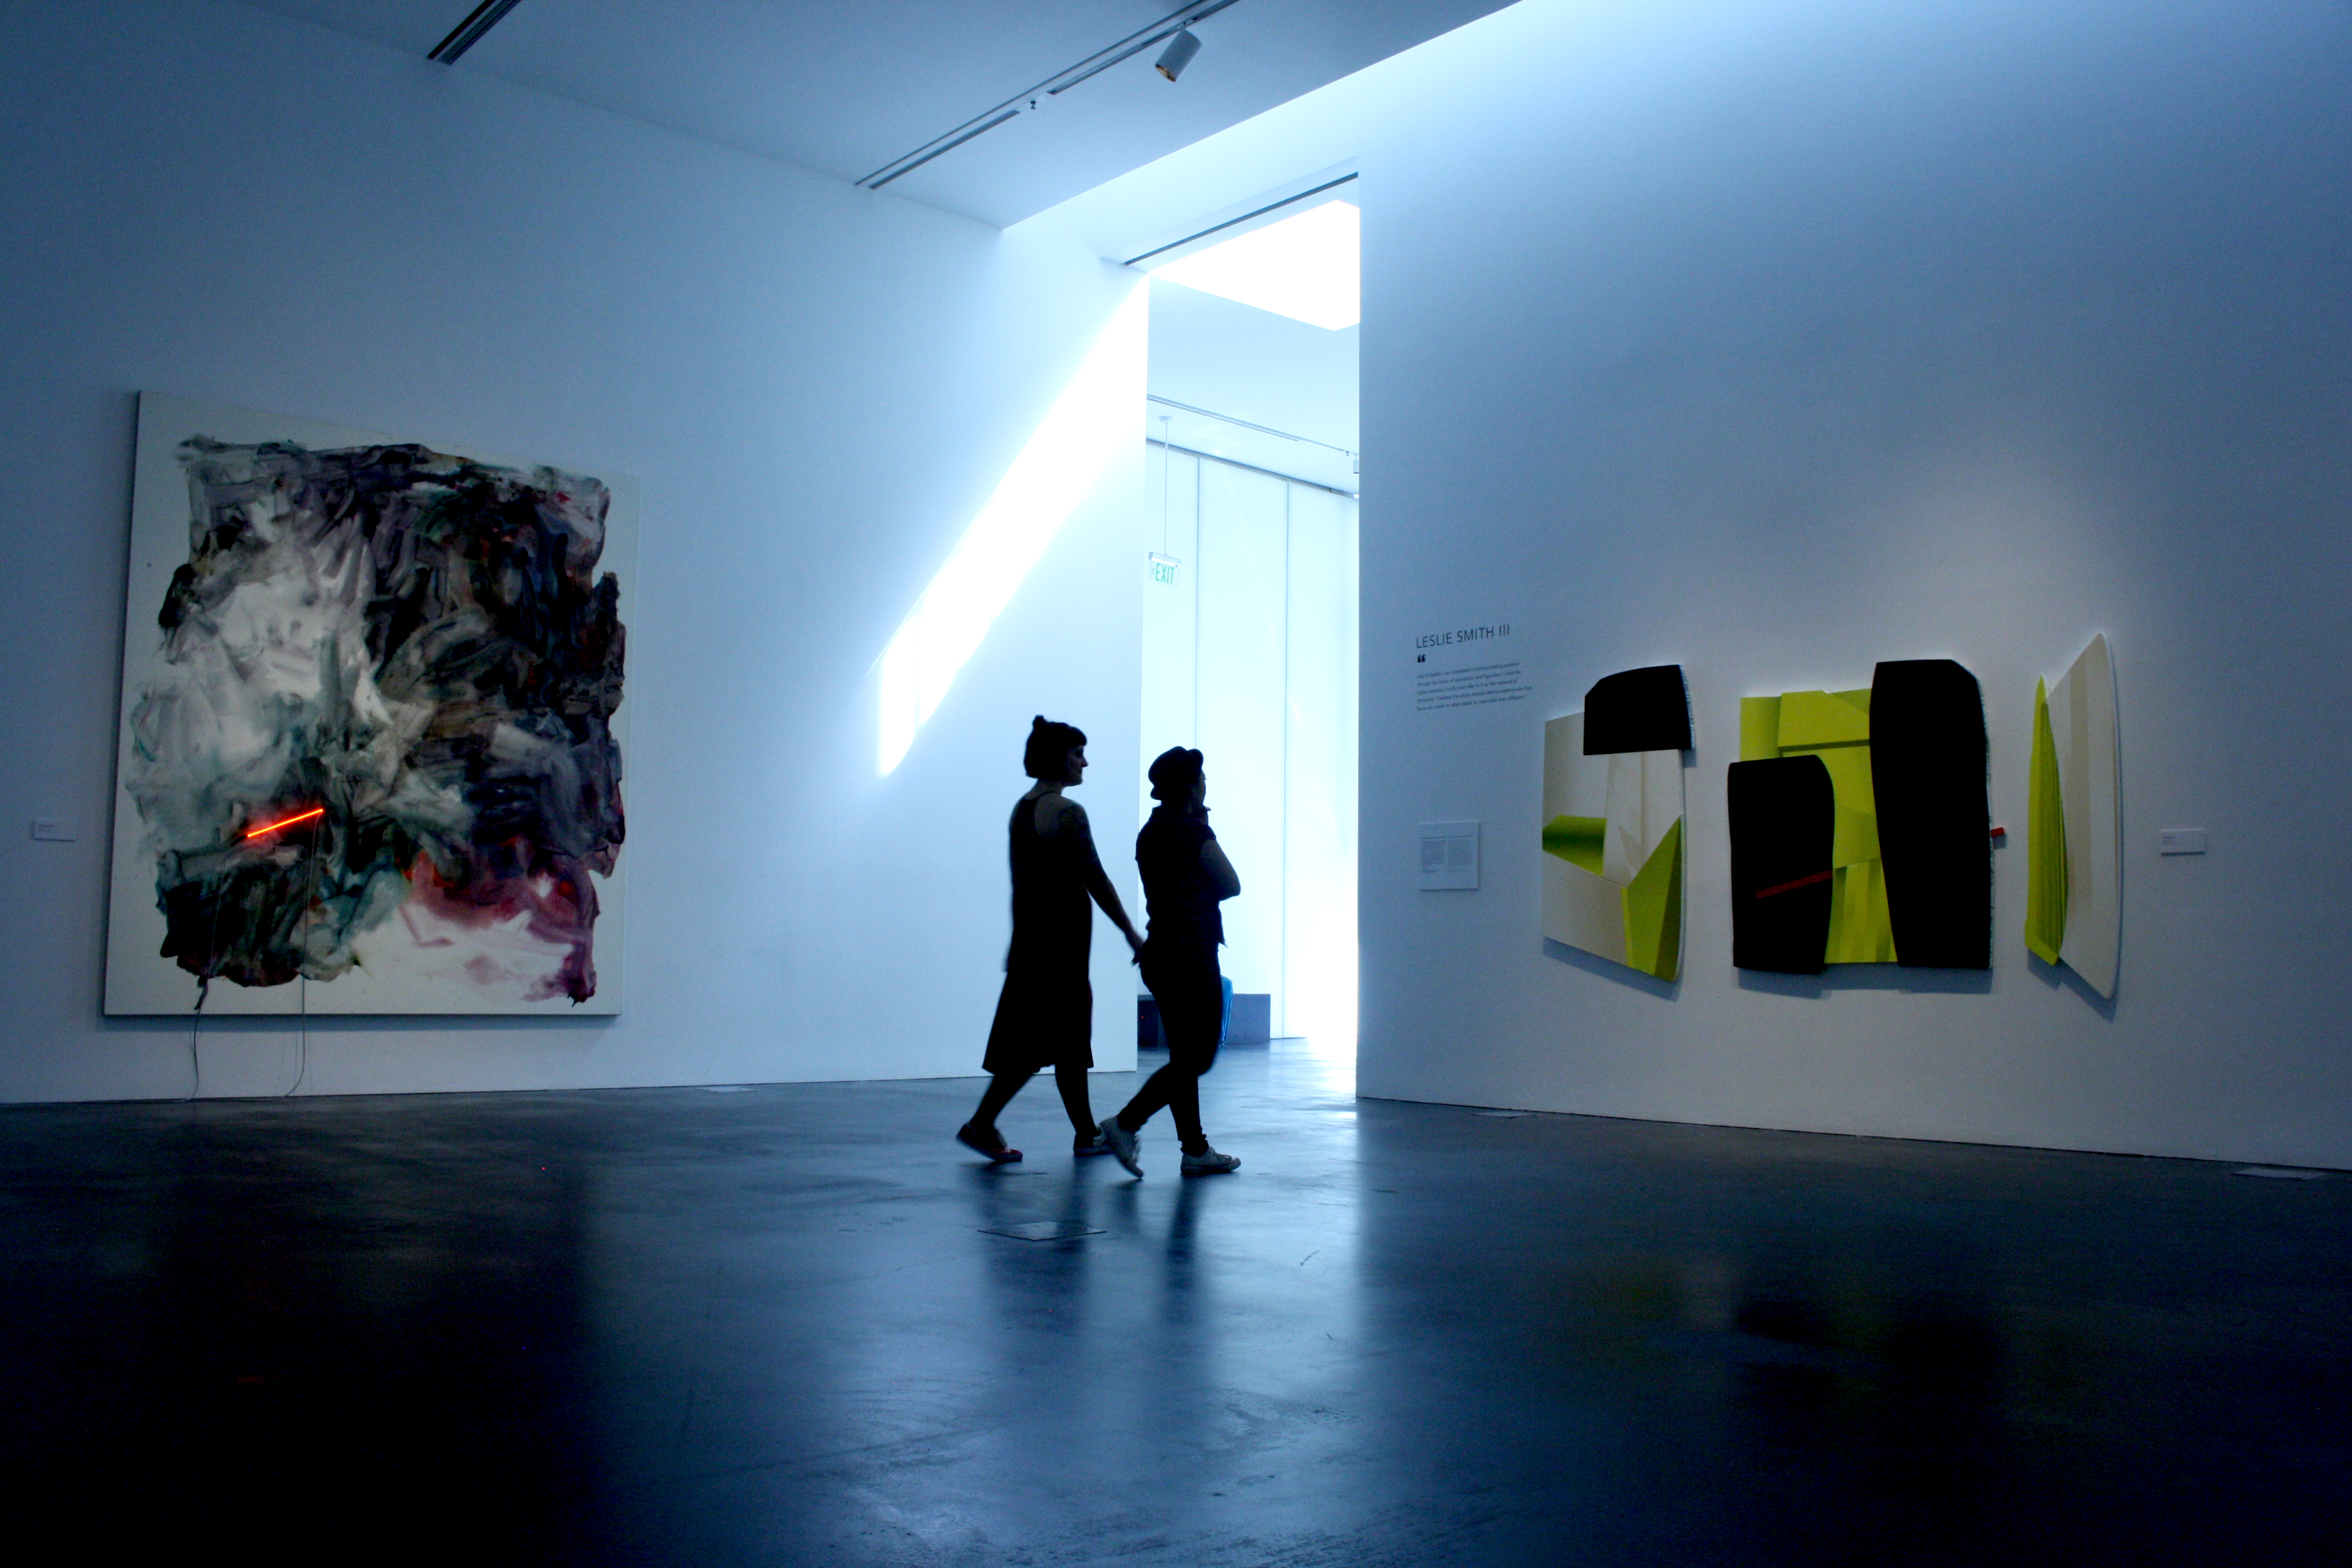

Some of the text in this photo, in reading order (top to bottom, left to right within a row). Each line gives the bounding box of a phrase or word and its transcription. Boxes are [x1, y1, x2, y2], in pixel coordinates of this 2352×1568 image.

[1155, 563, 1175, 585] EXIT
[1416, 624, 1510, 648] LESLIE SMITH III
